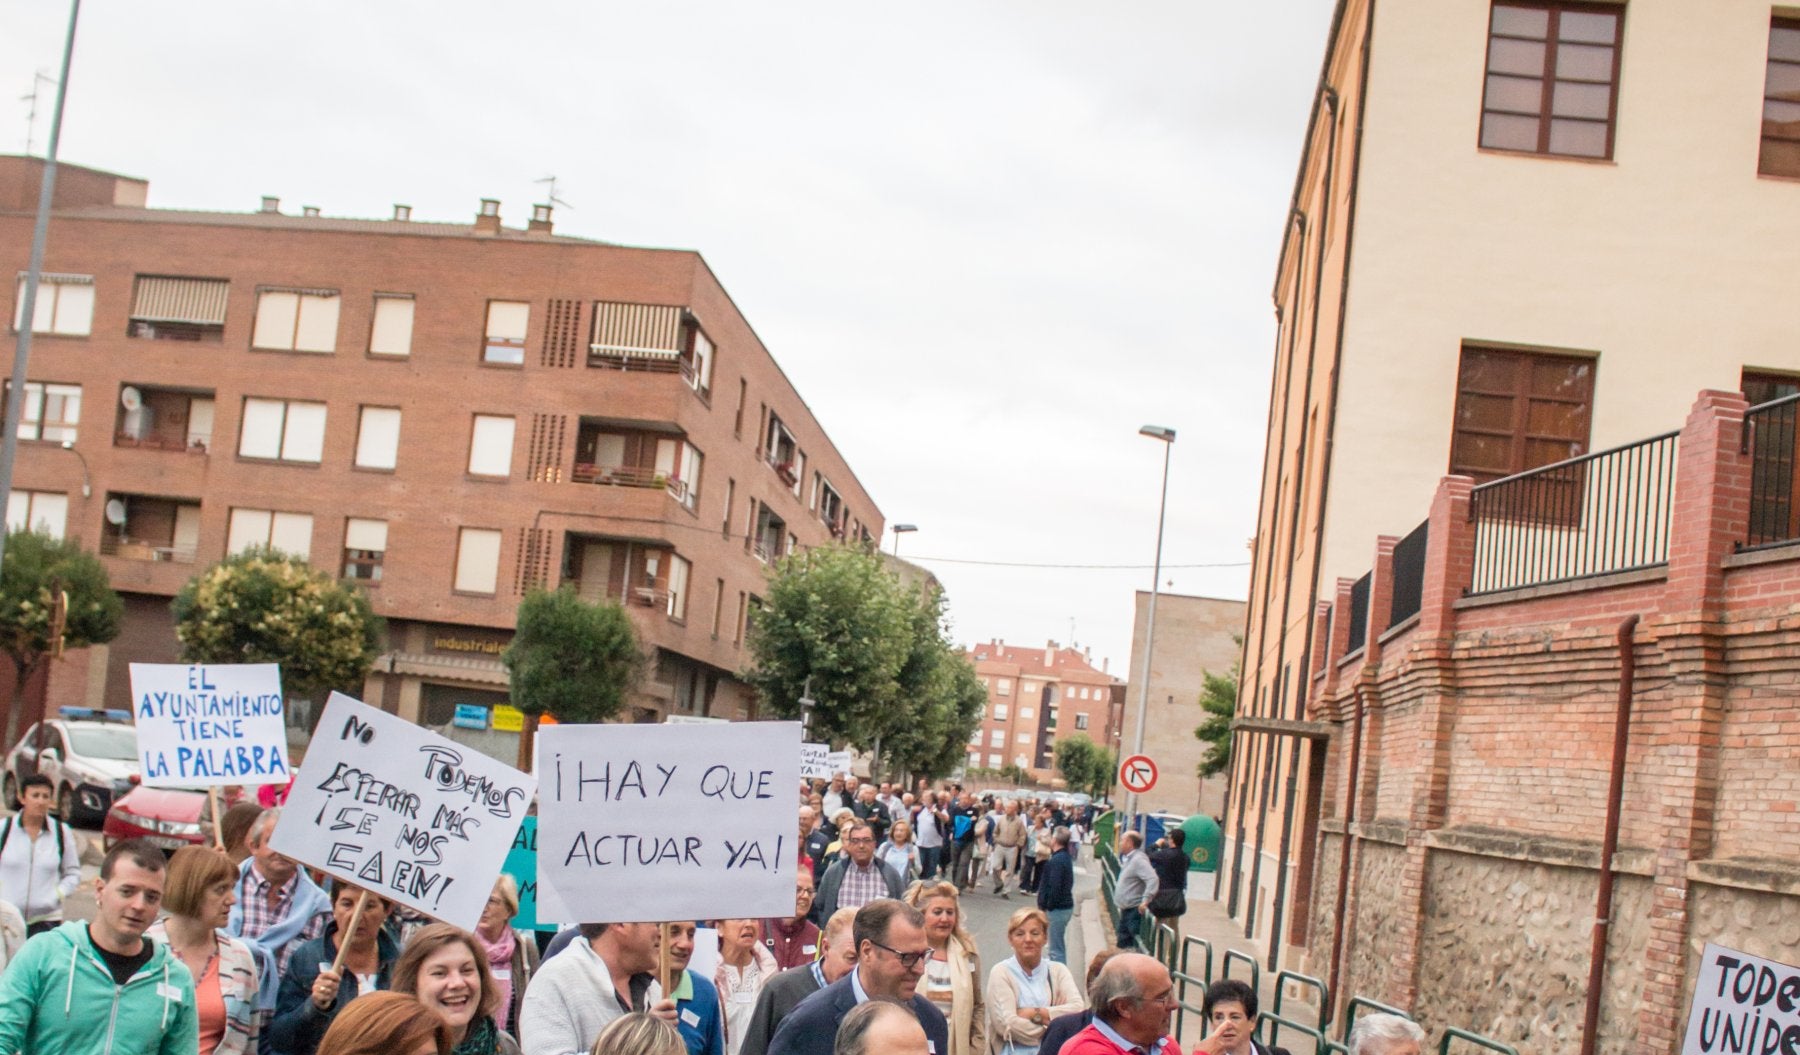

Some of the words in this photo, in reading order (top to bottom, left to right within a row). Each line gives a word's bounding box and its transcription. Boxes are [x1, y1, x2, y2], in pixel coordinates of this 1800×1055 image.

[188, 666, 216, 690] EL
[139, 691, 282, 719] AYUNTAMIENTO
[173, 717, 243, 741] TIENE
[146, 750, 169, 777] LA
[177, 745, 286, 777] PALABRA
[341, 715, 376, 744] NO
[419, 745, 525, 818] PODEMOS
[556, 754, 677, 802] ¡HAY
[701, 765, 774, 802] QUE
[317, 762, 421, 820] ESPERAR
[432, 806, 481, 841] MÁS
[395, 824, 449, 865] NOS
[564, 831, 703, 867] ACTUAR
[723, 834, 784, 874] YA!
[327, 842, 454, 911] CAEN!
